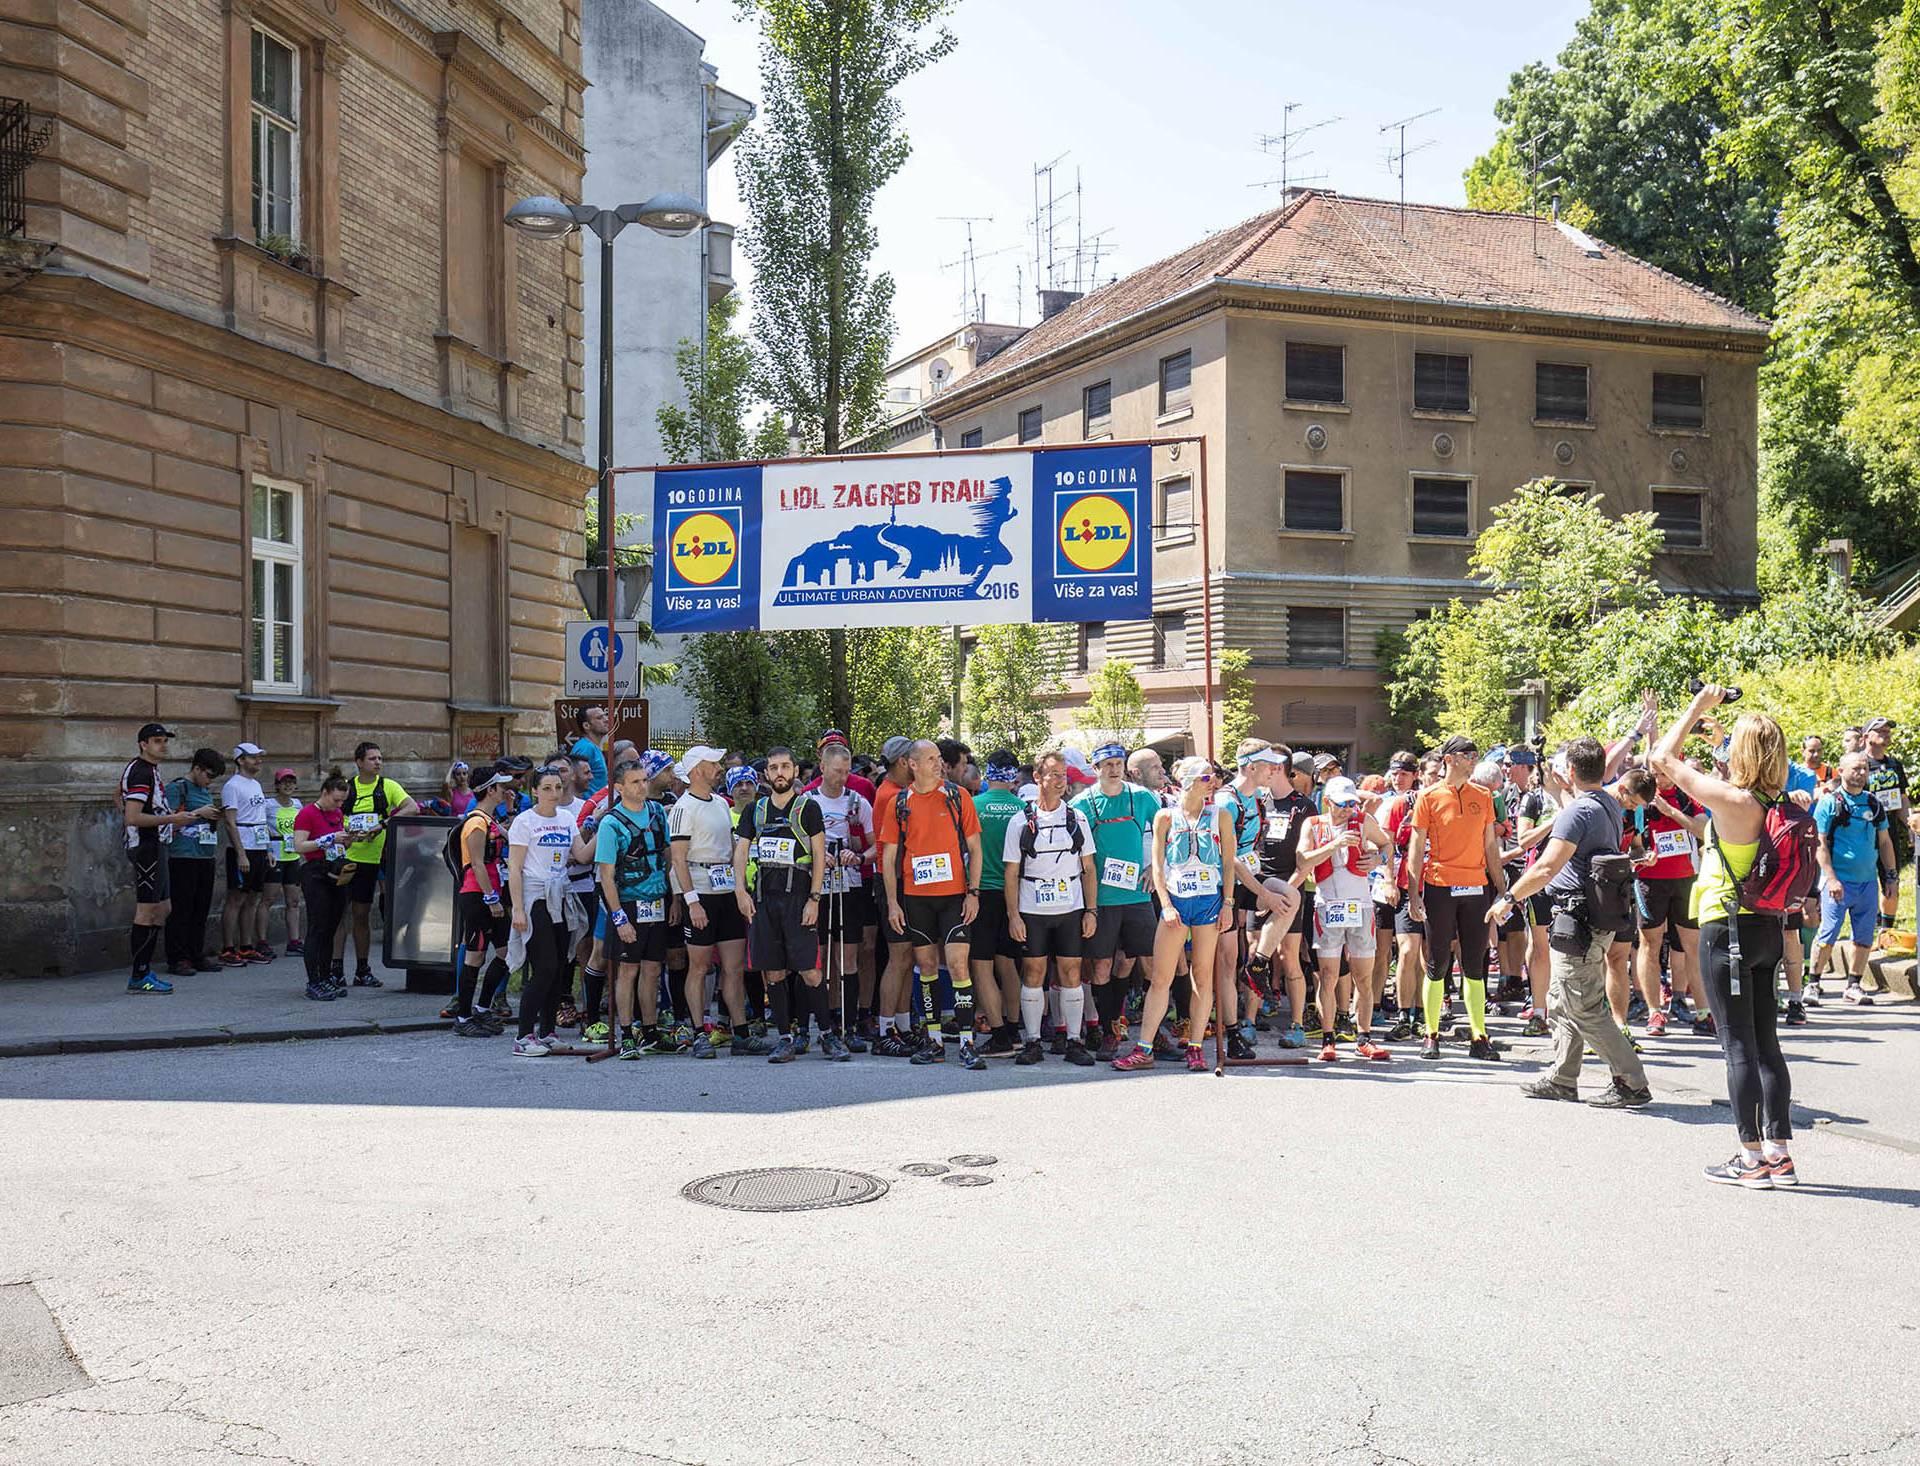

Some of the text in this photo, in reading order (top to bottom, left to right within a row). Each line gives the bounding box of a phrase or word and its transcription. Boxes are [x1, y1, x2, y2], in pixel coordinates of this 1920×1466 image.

[1078, 467, 1137, 485] GODINA
[688, 486, 742, 504] GODINA
[780, 478, 992, 511] LIDL ZAGREB TRAIL
[779, 586, 964, 603] ULTIMATE URBAN ADVENTURE
[983, 582, 1020, 600] 2016
[1054, 581, 1138, 599] Više za vas!
[665, 594, 741, 611] Više za vas!
[622, 703, 643, 722] put
[762, 849, 776, 859] 337
[917, 869, 933, 880] 351
[1107, 871, 1122, 882] 189
[1181, 881, 1198, 892] 345
[1040, 892, 1055, 902] 131
[1330, 913, 1345, 922] 266
